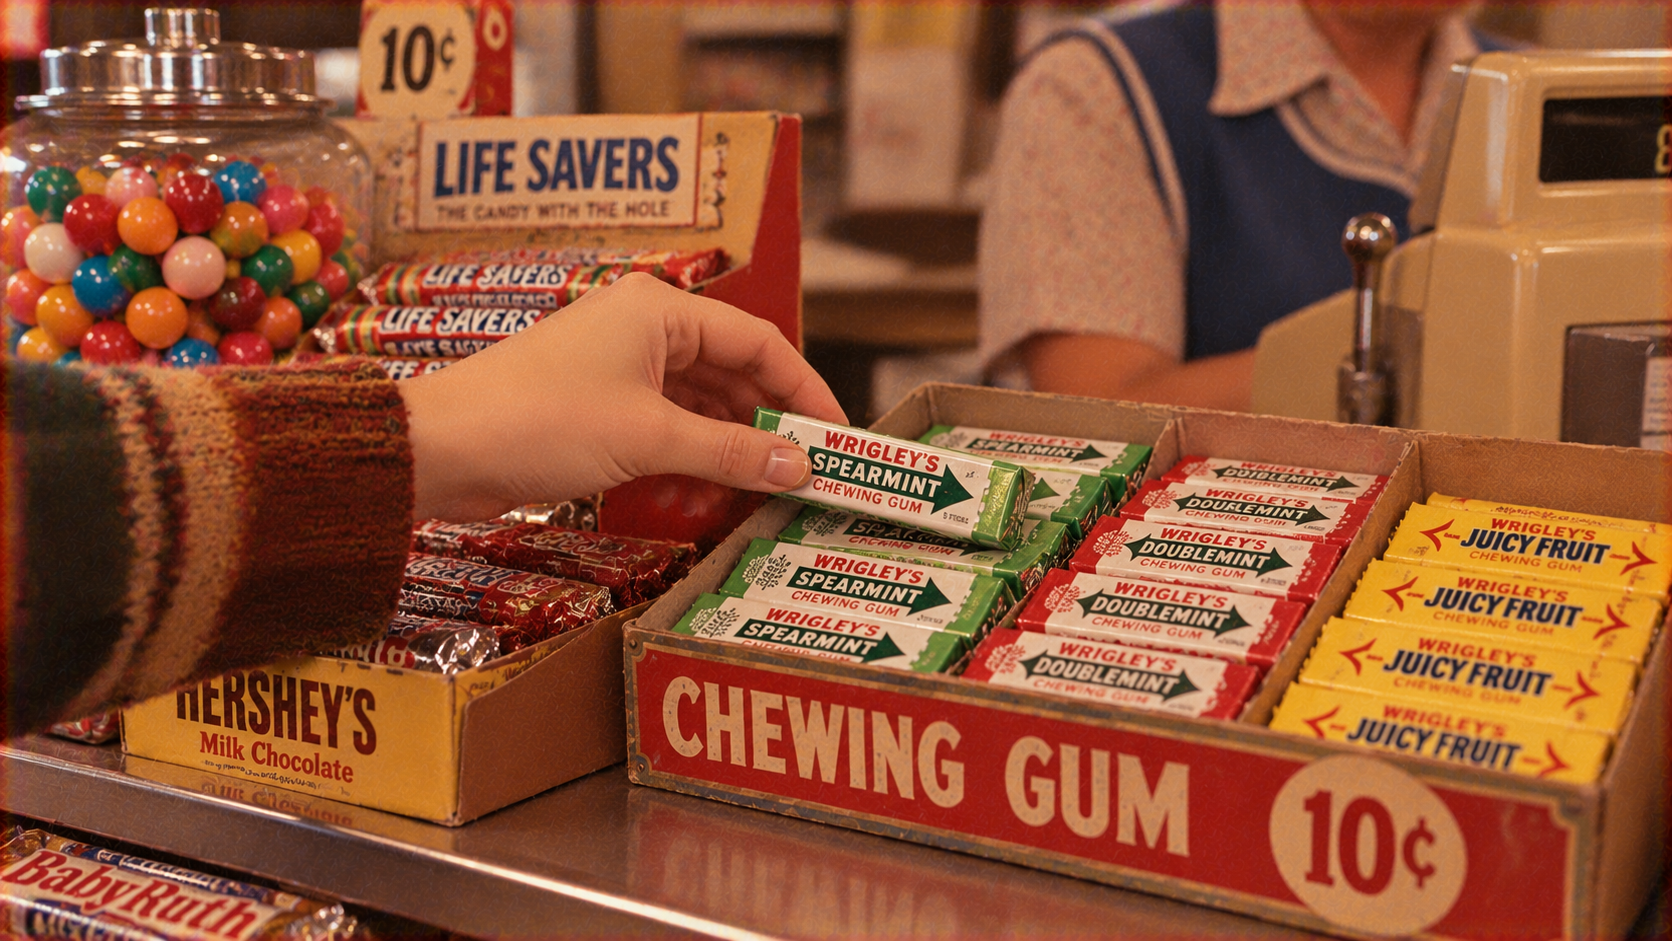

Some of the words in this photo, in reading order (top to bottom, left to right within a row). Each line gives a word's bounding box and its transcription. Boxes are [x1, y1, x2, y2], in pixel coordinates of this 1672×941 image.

[379, 25, 455, 92] 10¢
[434, 141, 516, 198] LIFE
[527, 136, 679, 193] SAVERS
[438, 205, 467, 222] THE
[473, 203, 529, 220] CANDY
[538, 202, 580, 219] WITH
[587, 201, 618, 218] THE
[625, 200, 669, 217] HOLE
[422, 264, 480, 289] LIFE
[378, 307, 440, 335] LIFE
[825, 430, 940, 473] WRIGLEY'S
[973, 438, 1083, 458] SPEARMINT
[813, 452, 942, 498] SPEARMINT
[813, 478, 883, 506] CHEWING
[888, 496, 922, 514] GUM
[1205, 488, 1309, 508] WRIGLEY'S
[1160, 527, 1267, 550] WRIGLEY'S
[1491, 518, 1596, 541] WRIGLEY'S
[1138, 541, 1271, 571] DOUBLEMINT
[1460, 528, 1538, 556] JUICY
[1533, 536, 1611, 565] FRUIT
[1469, 550, 1541, 568] CHEWING
[1547, 561, 1583, 573] GUM
[813, 553, 924, 584] WRIGLEY'S
[1140, 558, 1207, 575] CHEWING
[1213, 566, 1246, 579] GUM
[795, 571, 923, 605] SPEARMINT
[1114, 581, 1229, 609] WRIGLEY'S
[1457, 576, 1569, 603] WRIGLEY'S
[791, 590, 859, 610] CHEWING
[864, 602, 901, 617] GUM
[1090, 596, 1231, 629] DOUBLEMINT
[1424, 586, 1505, 616] JUICY
[1502, 596, 1584, 628] FRUIT
[765, 607, 880, 637] WRIGLEY'S
[1091, 616, 1161, 634] CHEWING
[1169, 626, 1203, 640] GUM
[1433, 611, 1510, 630] CHEWING
[1516, 623, 1554, 636] GUM
[744, 623, 878, 656] SPEARMINT
[1418, 637, 1538, 668] WRIGLEY'S
[1058, 642, 1178, 672] WRIGLEY'S
[1032, 657, 1180, 694] DOUBLEMINT
[1383, 650, 1468, 683] JUICY
[1466, 662, 1552, 697] FRUIT
[1033, 678, 1107, 698] CHEWING
[1112, 690, 1149, 705] GUM
[1393, 676, 1473, 698] CHEWING
[1480, 690, 1521, 705] GUM
[1382, 705, 1508, 738] WRIGLEY'S
[200, 731, 245, 761] Milk
[251, 741, 354, 783] Chocolate
[1346, 718, 1433, 752] JUICY
[1433, 732, 1521, 770] FRUIT
[662, 675, 965, 809] CHEWING
[1003, 736, 1191, 857] GUM
[1302, 789, 1438, 897] 10¢
